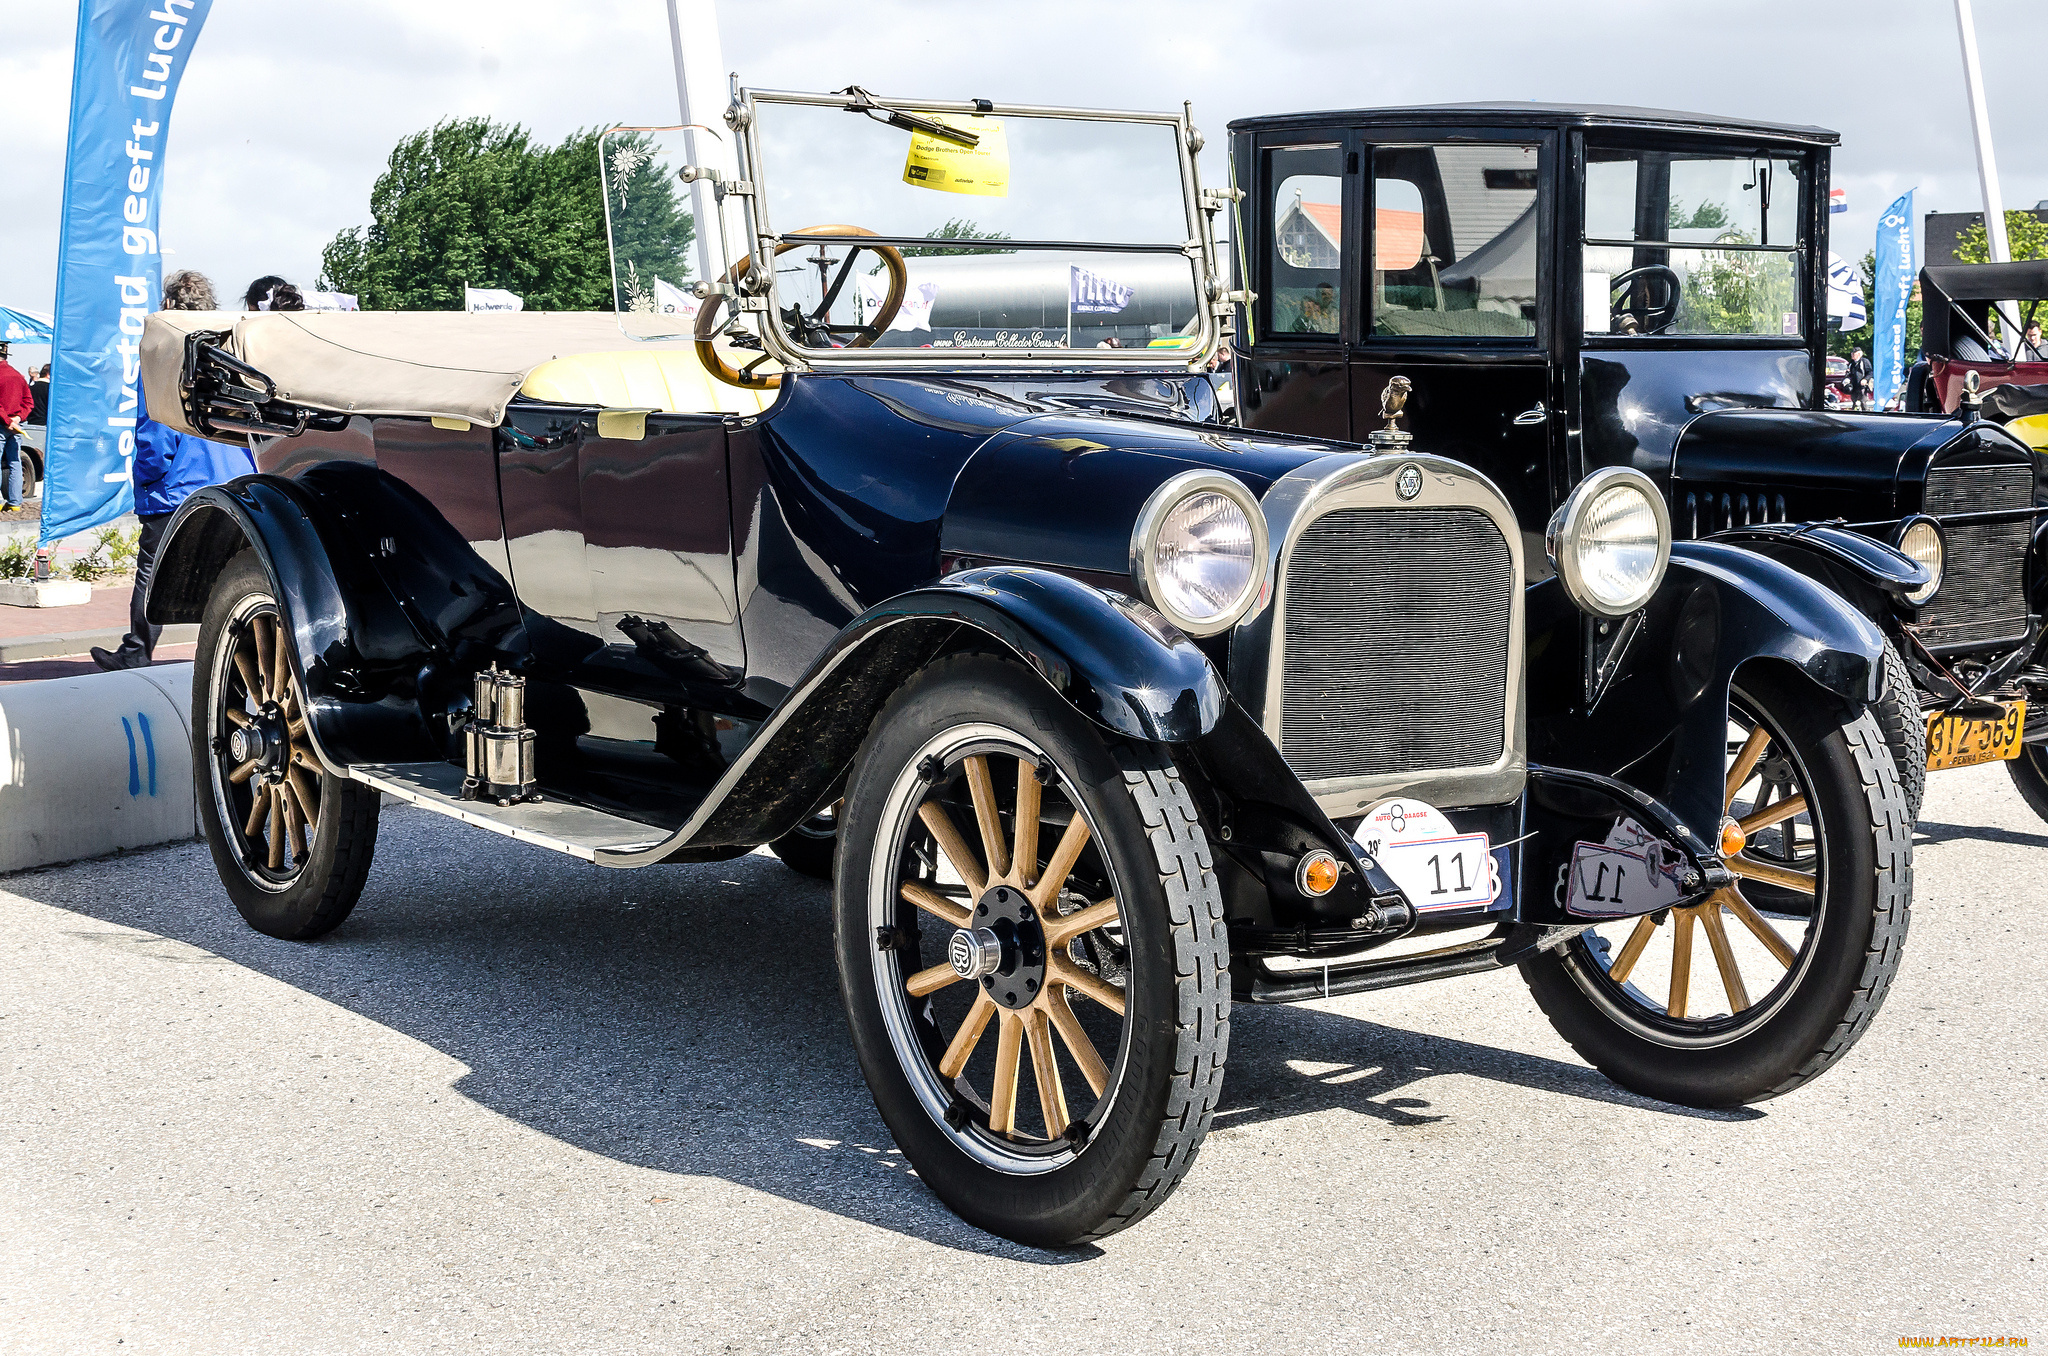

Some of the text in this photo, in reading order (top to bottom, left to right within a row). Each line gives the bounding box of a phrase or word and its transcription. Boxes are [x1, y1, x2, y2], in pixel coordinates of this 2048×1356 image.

[915, 144, 934, 153] Dodge
[935, 146, 959, 154] Brothers
[122, 118, 159, 255] geeft
[473, 302, 513, 311] Holwerda
[1891, 324, 1903, 393] Lelystad
[1897, 226, 1911, 270] lucht
[1390, 803, 1406, 832] 8
[1403, 811, 1428, 819] DAAGSE
[1427, 851, 1472, 895] 11
